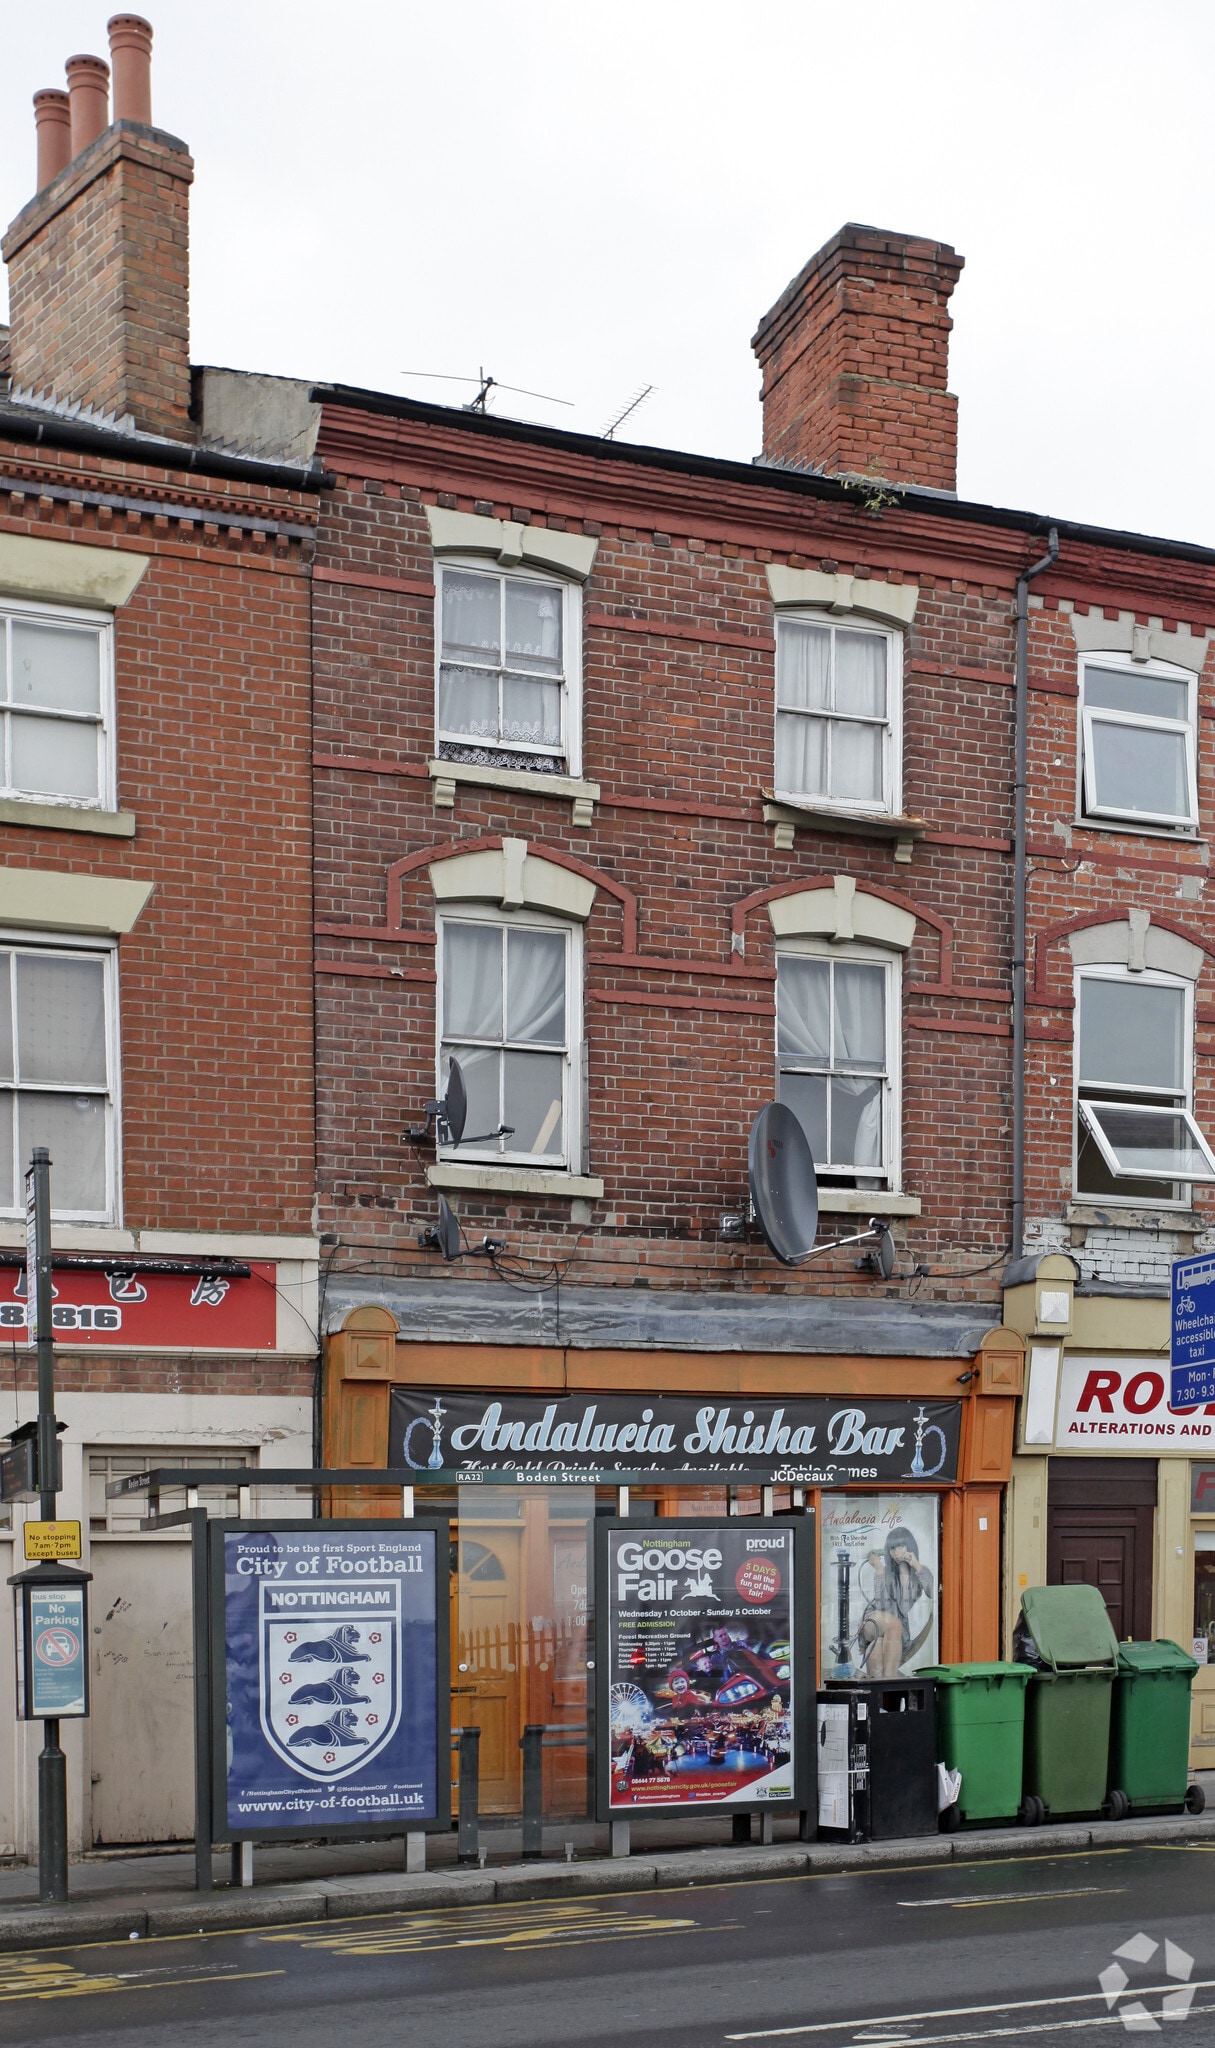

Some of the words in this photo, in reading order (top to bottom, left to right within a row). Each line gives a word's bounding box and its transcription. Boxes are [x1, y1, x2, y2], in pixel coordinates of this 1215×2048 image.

[0, 1304, 120, 1330] 8816
[1189, 1345, 1205, 1358] taxi
[1188, 1371, 1206, 1383] Mon
[1076, 1370, 1215, 1416] RO
[450, 1402, 678, 1454] Andalucia
[683, 1406, 817, 1455] Shisha
[827, 1408, 906, 1456] Bar
[1068, 1422, 1175, 1436] ALTERATIONS
[1180, 1424, 1212, 1436] AND
[458, 1473, 482, 1482] RA22
[516, 1472, 557, 1482] Boden
[562, 1472, 601, 1483] Street
[770, 1470, 834, 1482] JCDecaux
[881, 1509, 904, 1528] Life
[237, 1545, 270, 1554] Proud
[272, 1545, 284, 1553] to
[286, 1545, 300, 1553] be
[302, 1544, 320, 1552] the
[322, 1544, 344, 1552] first
[346, 1544, 376, 1554] Sport
[378, 1544, 422, 1553] England
[642, 1540, 691, 1548] Nottingham
[746, 1536, 784, 1551] proud
[616, 1542, 722, 1571] Goose
[236, 1556, 288, 1578] City
[295, 1556, 320, 1574] of
[326, 1555, 424, 1574] Football
[752, 1564, 777, 1576] DAYS
[740, 1579, 752, 1588] fun
[762, 1584, 775, 1592] the
[763, 1576, 775, 1584] the
[618, 1572, 678, 1602] Fair
[271, 1591, 390, 1606] NOTTINGHAM
[748, 1589, 764, 1598] fair!
[48, 1604, 66, 1613] No
[618, 1610, 662, 1618] Wednesday
[670, 1609, 701, 1617] October
[706, 1609, 734, 1618] Sunday
[742, 1608, 772, 1616] October
[35, 1616, 79, 1626] Parking
[631, 1781, 737, 1792] www.nottinghamcity.gov.uk/goosefair
[237, 1792, 424, 1813] www.city-of-football.uk
